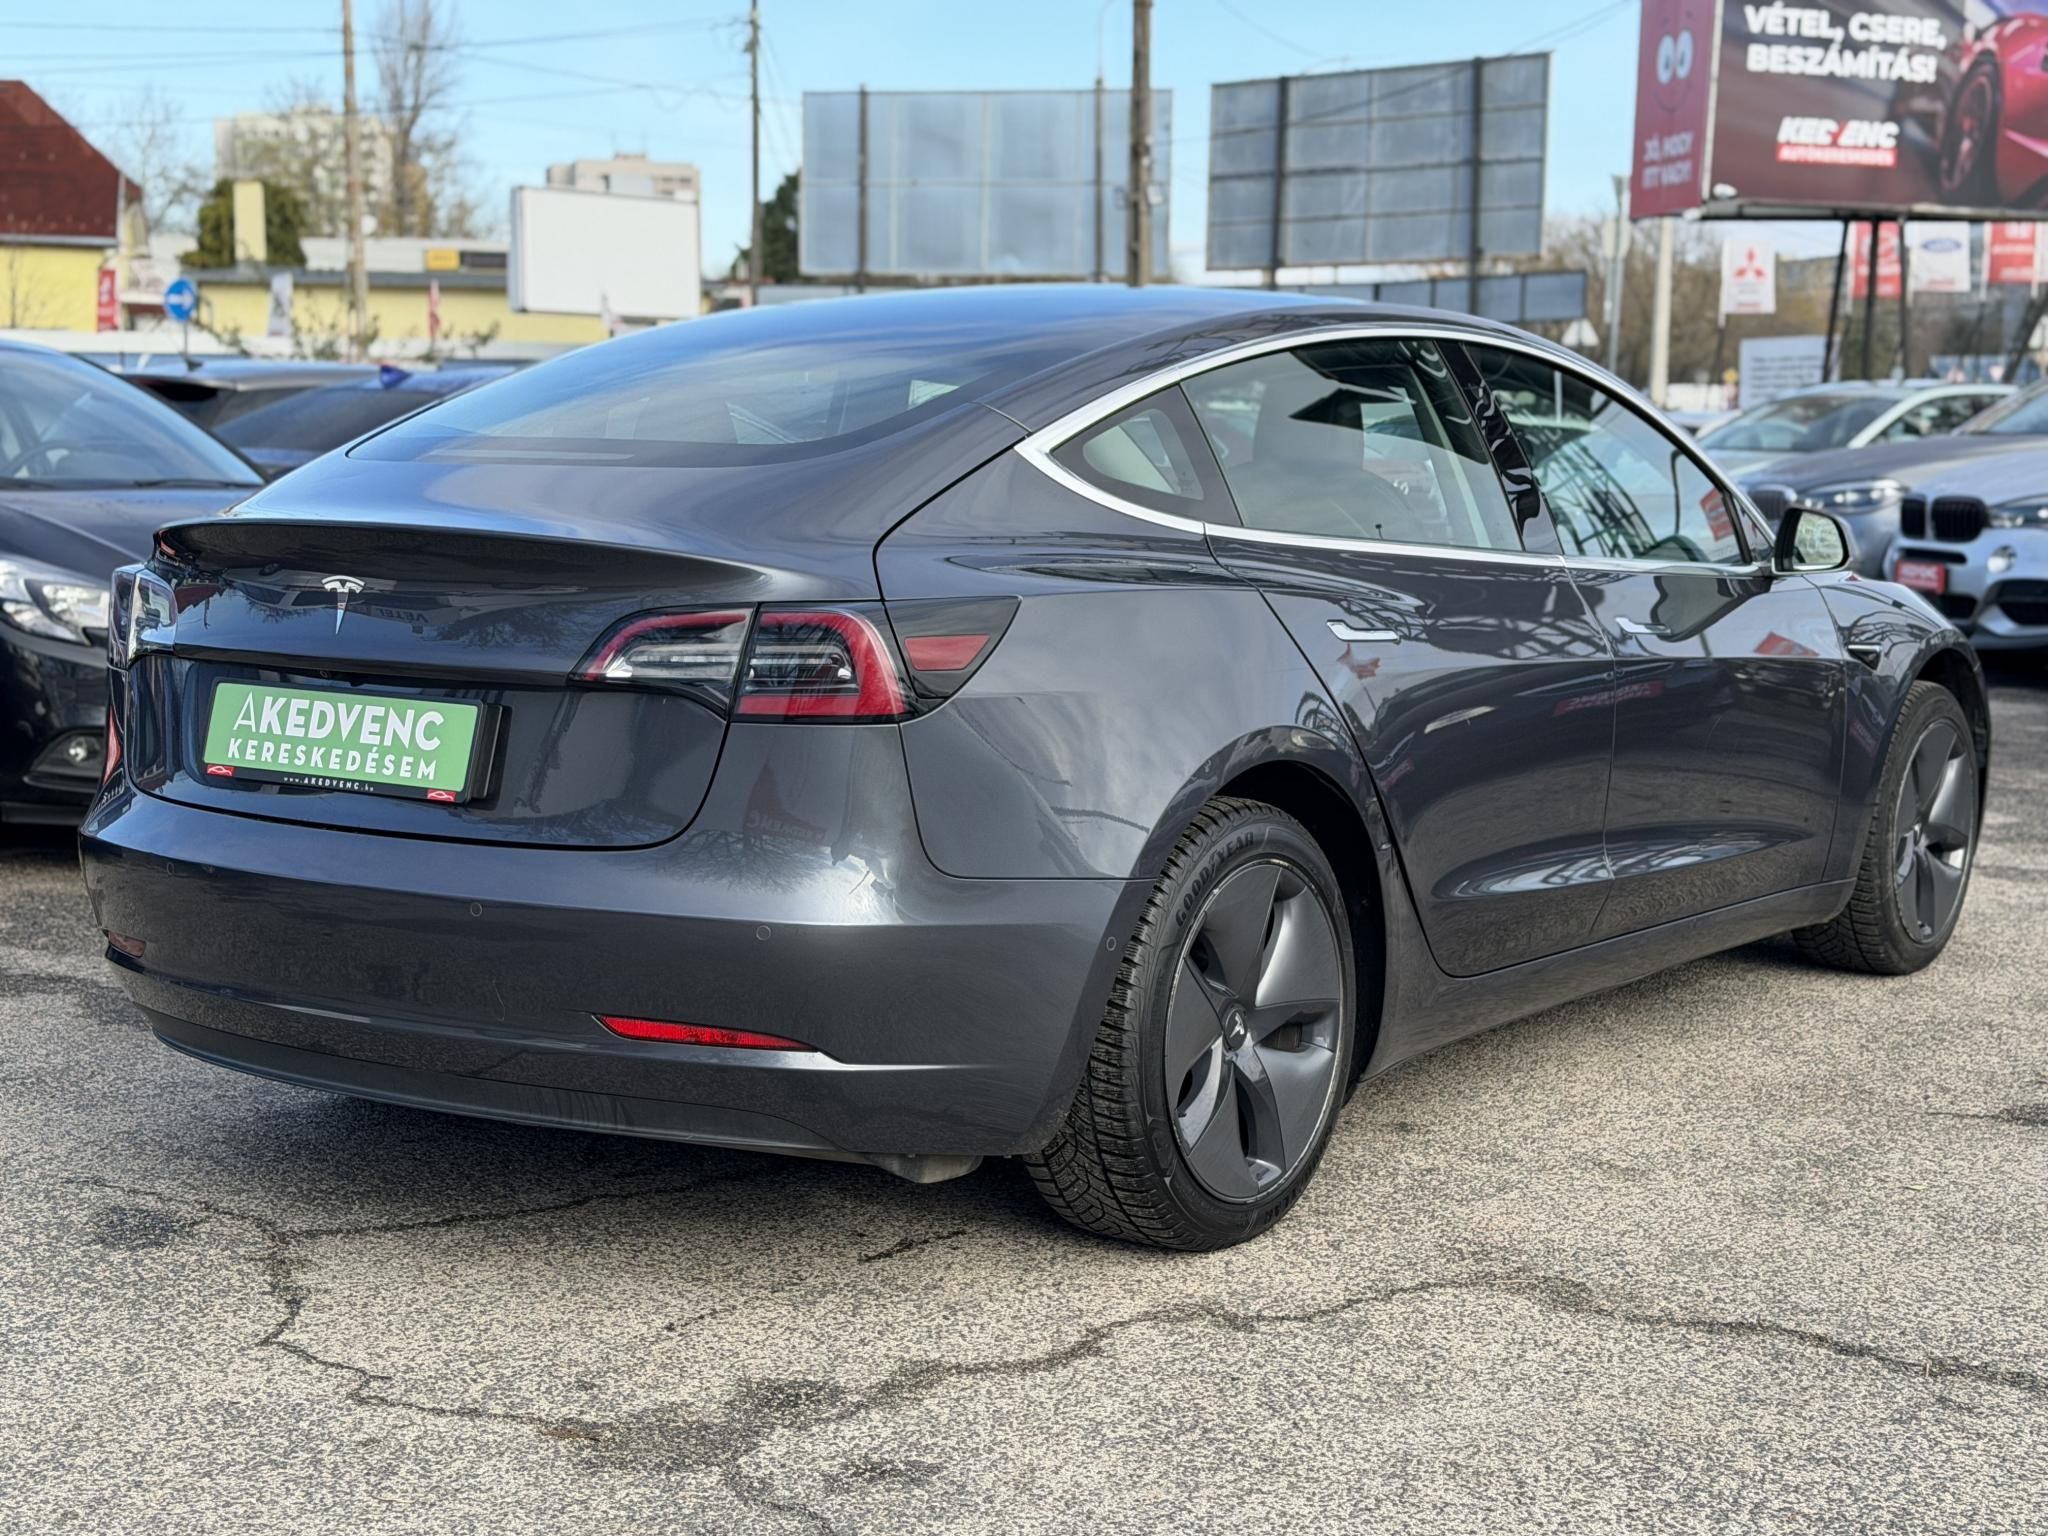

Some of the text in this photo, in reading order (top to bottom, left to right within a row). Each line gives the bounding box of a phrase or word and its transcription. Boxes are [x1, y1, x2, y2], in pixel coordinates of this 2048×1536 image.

[1744, 1, 1948, 50] VÉTEL, CSERE,
[1746, 42, 1937, 83] BESZÁMÍTÁS!
[227, 737, 437, 780] KERESKEDÉSEM
[1175, 830, 1254, 927] GOODYEAR
